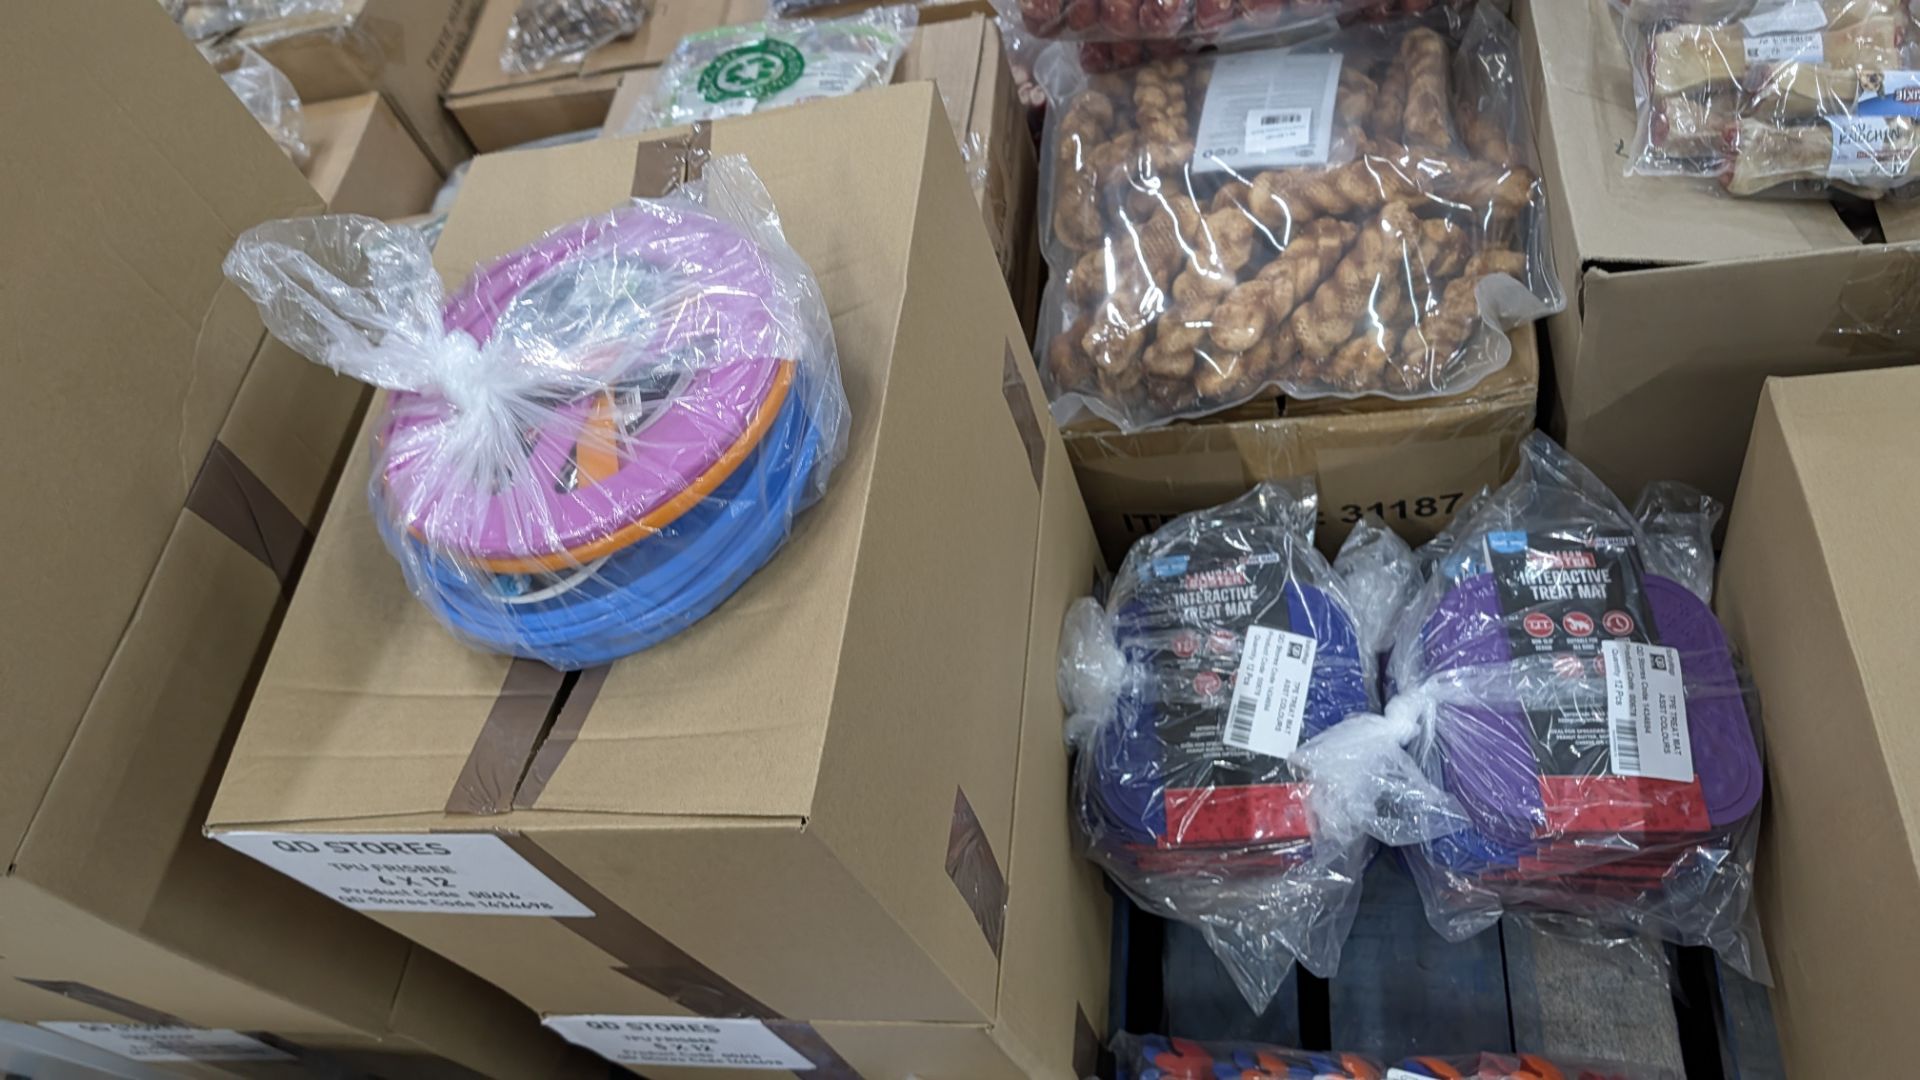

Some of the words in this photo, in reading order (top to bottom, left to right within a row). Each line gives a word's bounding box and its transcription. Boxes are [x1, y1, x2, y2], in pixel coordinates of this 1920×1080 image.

[1341, 492, 1463, 523] 31187
[1518, 568, 1612, 585] INTERACTIVE
[1172, 584, 1258, 606] INTERACTIVE
[1530, 584, 1574, 601] TREAT
[1577, 583, 1608, 600] MAT
[1184, 604, 1222, 620] TREAT
[1224, 600, 1253, 616] MAT
[1670, 709, 1679, 737] TREAT
[1660, 715, 1671, 755] COLOURS
[272, 840, 320, 853] QD
[324, 841, 451, 856] STORES
[328, 862, 369, 872] TPU
[371, 863, 457, 874] FRISBEE
[378, 875, 395, 886] 6
[422, 876, 456, 888] 12
[586, 1021, 620, 1030] QD
[625, 1022, 721, 1033] STORES
